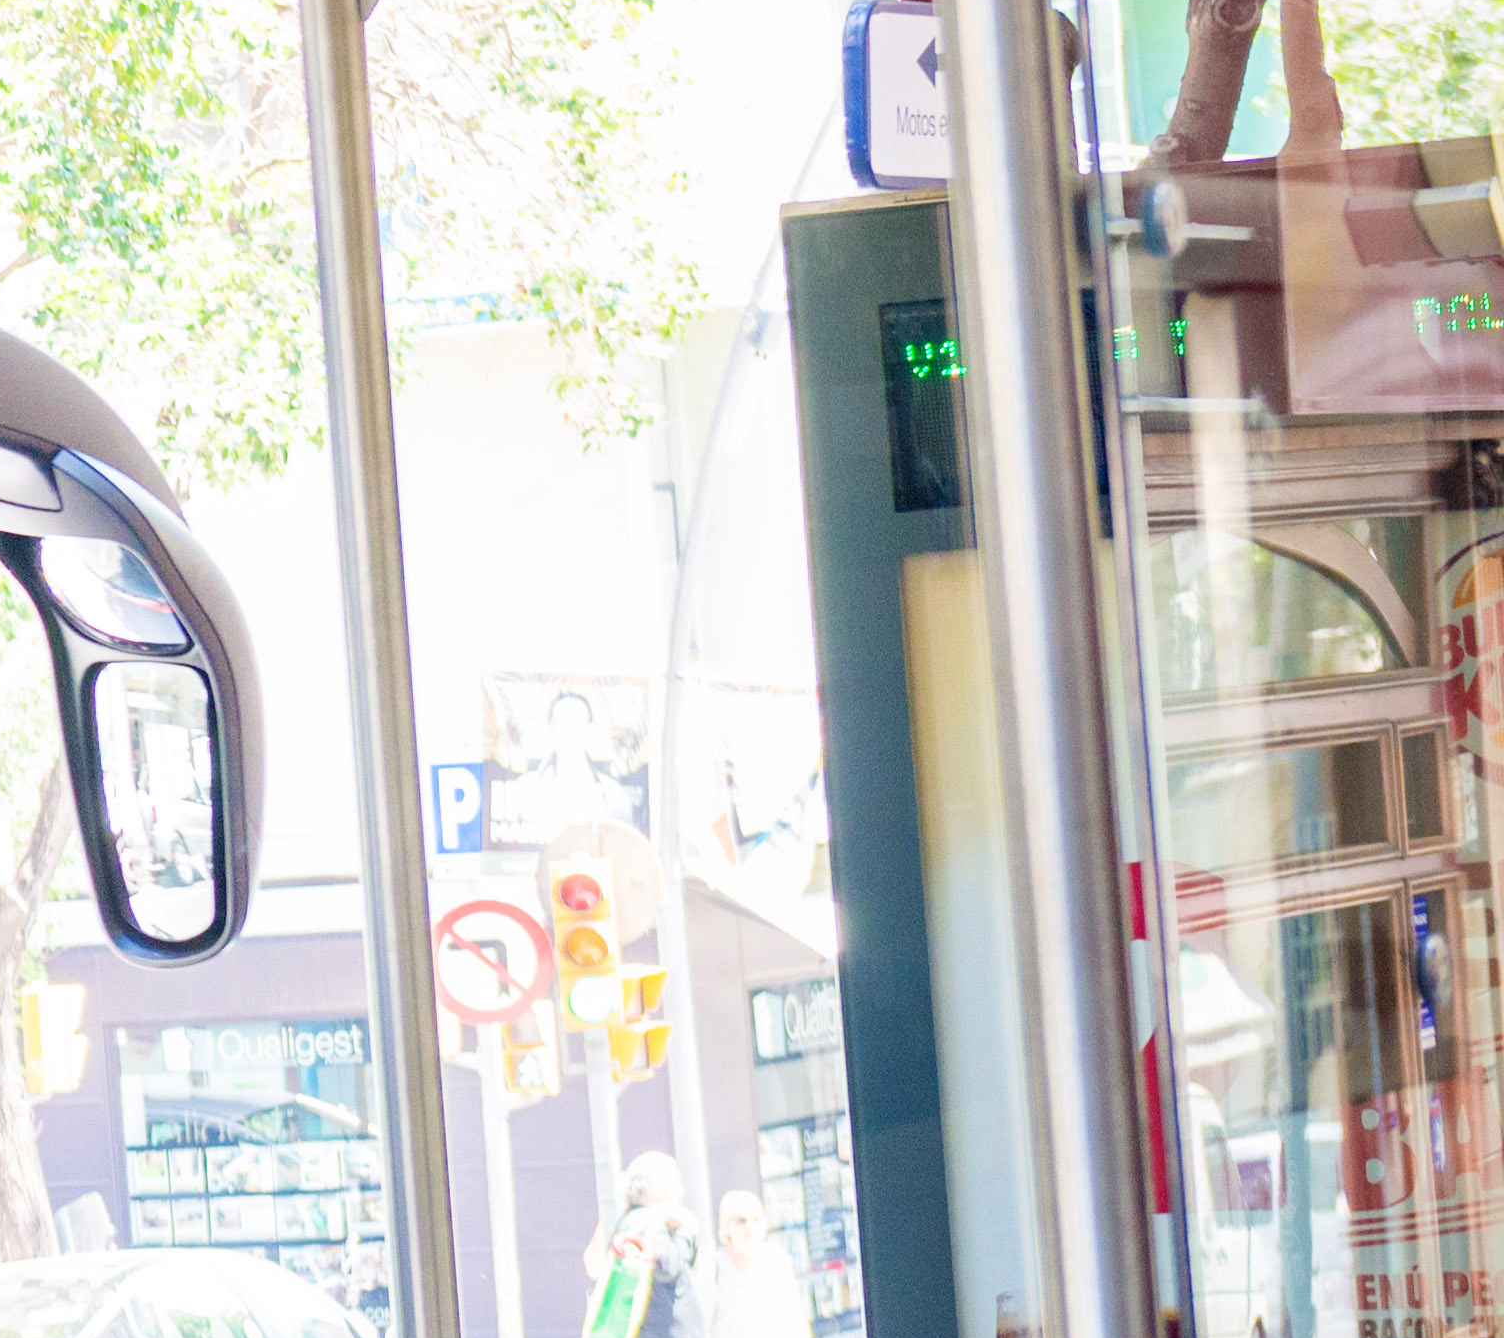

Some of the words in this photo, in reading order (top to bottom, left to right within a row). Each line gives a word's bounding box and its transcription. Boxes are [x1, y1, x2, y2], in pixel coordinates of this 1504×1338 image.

[896, 104, 937, 138] Motos
[904, 338, 968, 380] V1
[1438, 599, 1504, 670] BU
[438, 765, 481, 851] P
[217, 1025, 363, 1066] Qualigest
